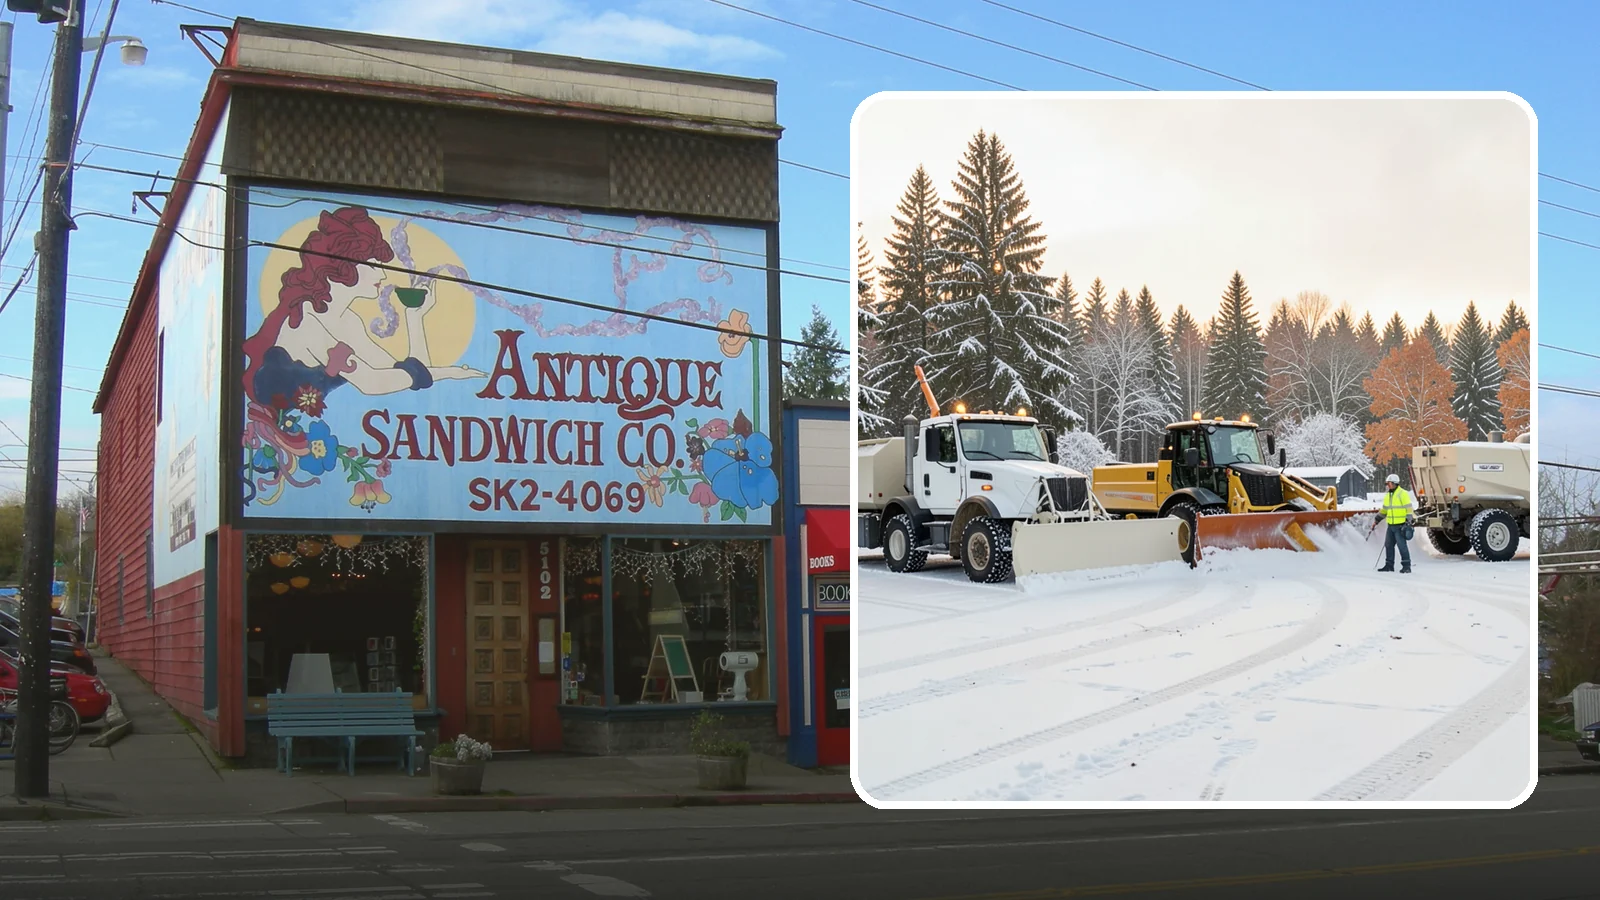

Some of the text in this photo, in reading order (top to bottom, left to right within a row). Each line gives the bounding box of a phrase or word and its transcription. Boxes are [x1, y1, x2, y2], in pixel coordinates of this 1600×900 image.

[361, 408, 685, 469] SANDWICH CO.
[469, 477, 645, 513] SK2-4069
[539, 542, 552, 600] 5102
[809, 555, 835, 569] BOOKS
